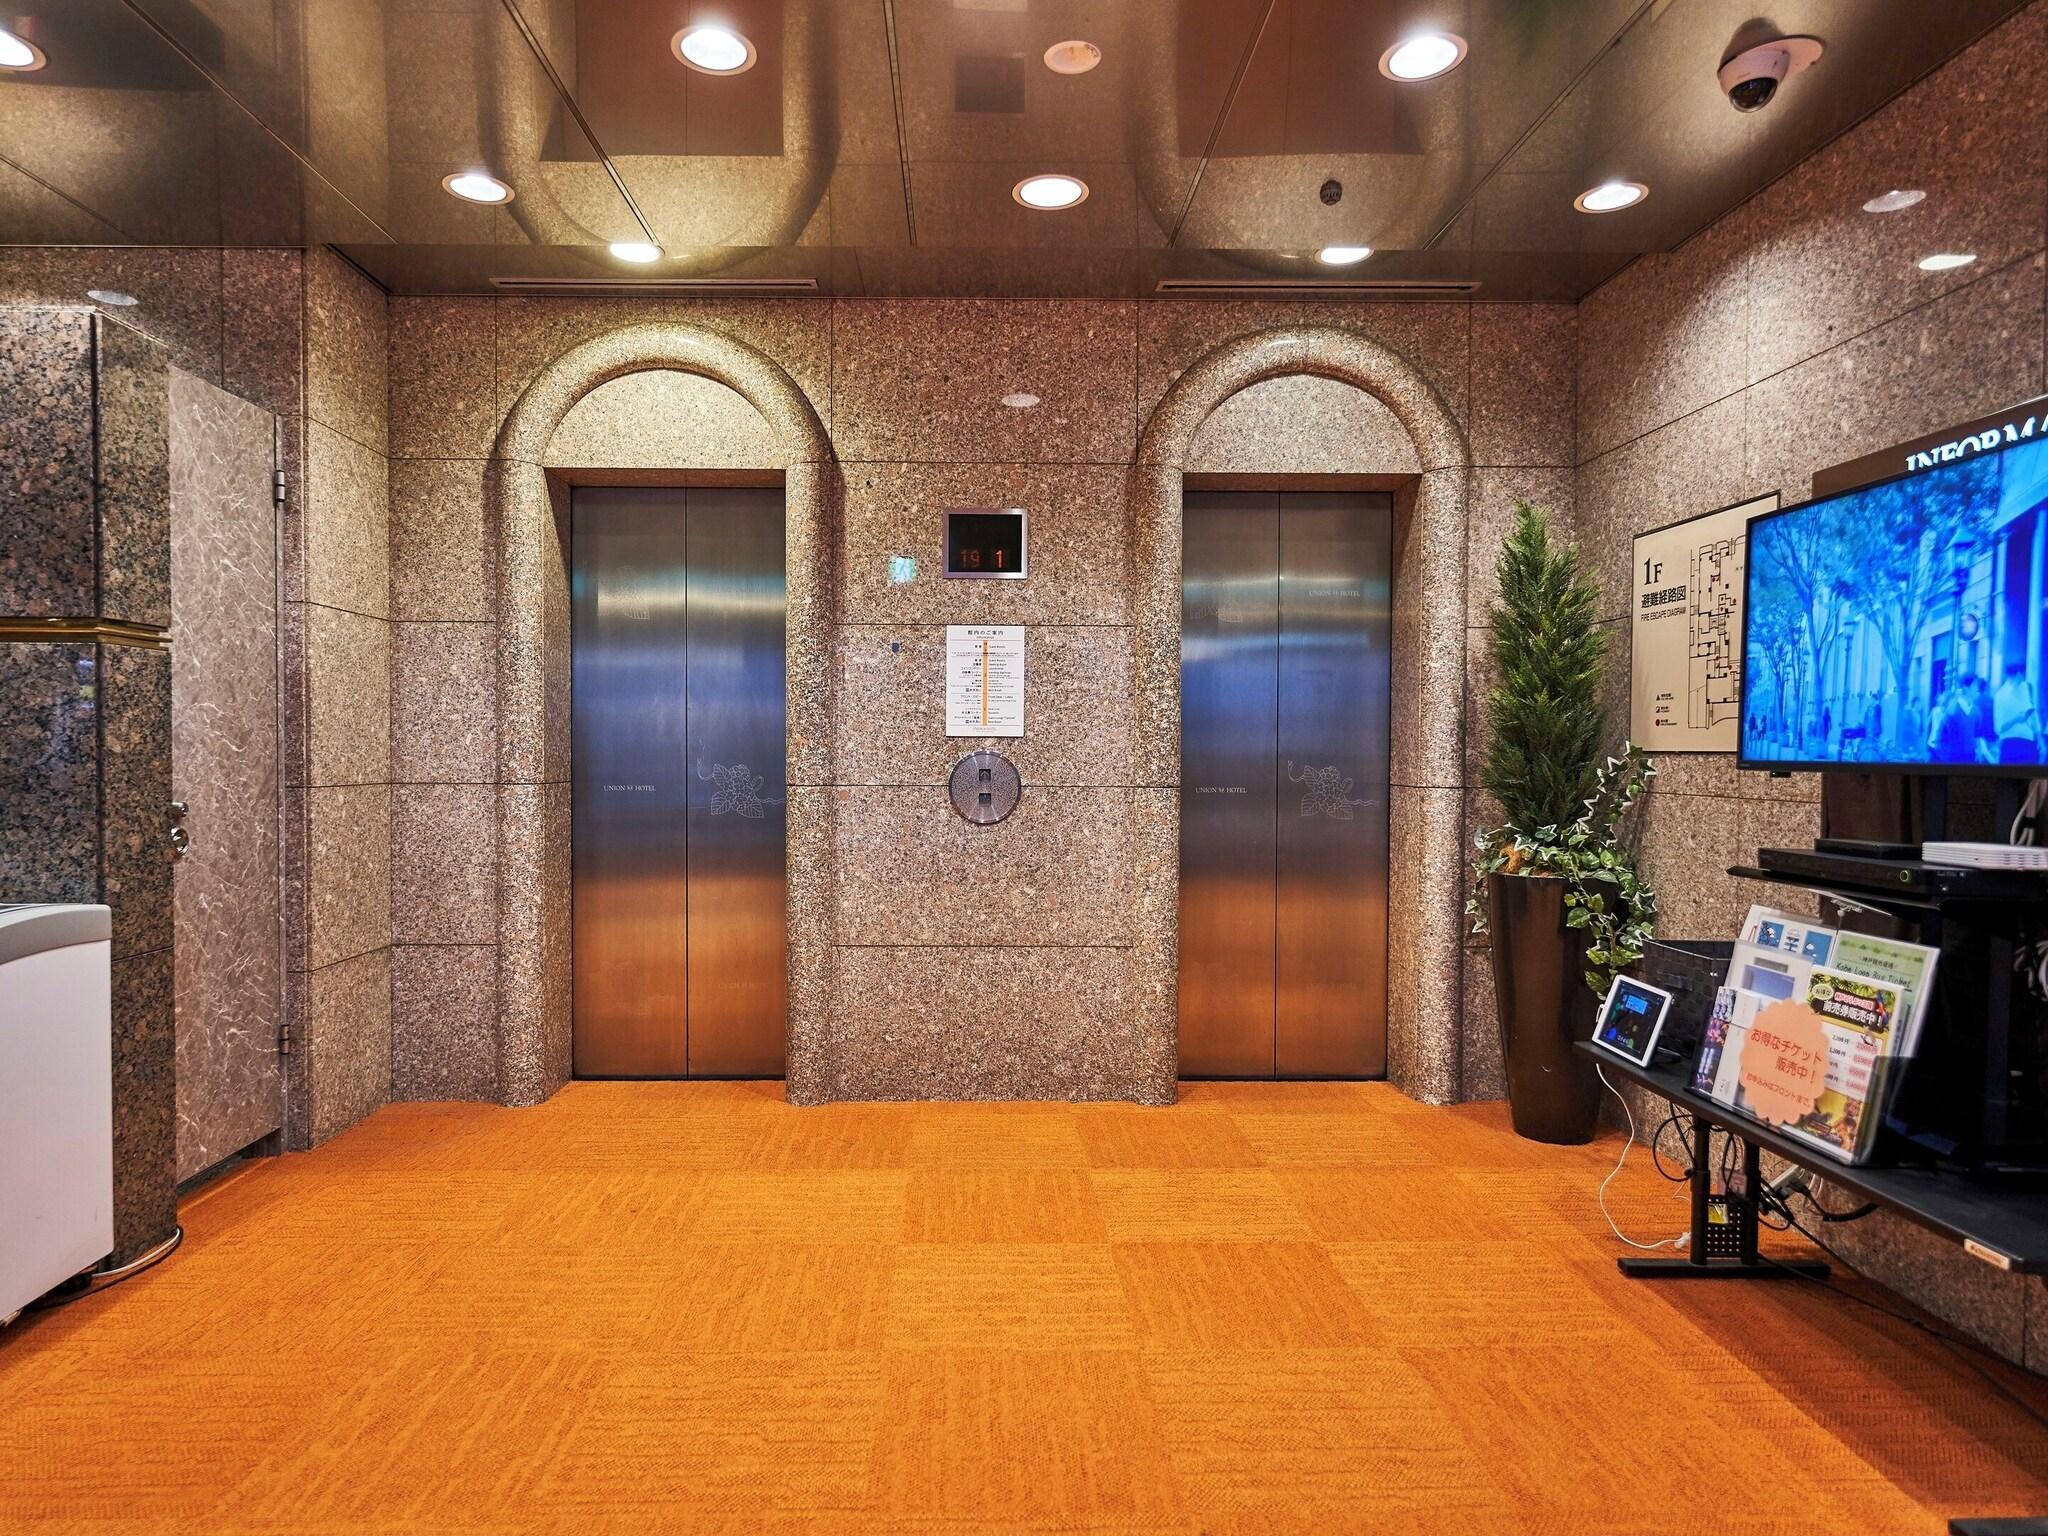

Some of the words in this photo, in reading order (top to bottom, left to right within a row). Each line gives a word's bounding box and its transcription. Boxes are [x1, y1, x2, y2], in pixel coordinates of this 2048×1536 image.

[1905, 414, 2048, 472] INFORM
[960, 548, 980, 569] 19
[994, 548, 1004, 569] 1
[1643, 557, 1663, 586] 1F
[1641, 585, 1686, 608] 避難経路図
[1650, 609, 1667, 621] ESCAPE
[603, 784, 626, 792] UNION
[635, 784, 657, 792] HOTEL
[1750, 1028, 1822, 1065] お得なチケット
[1776, 1055, 1816, 1084] 販売中！
